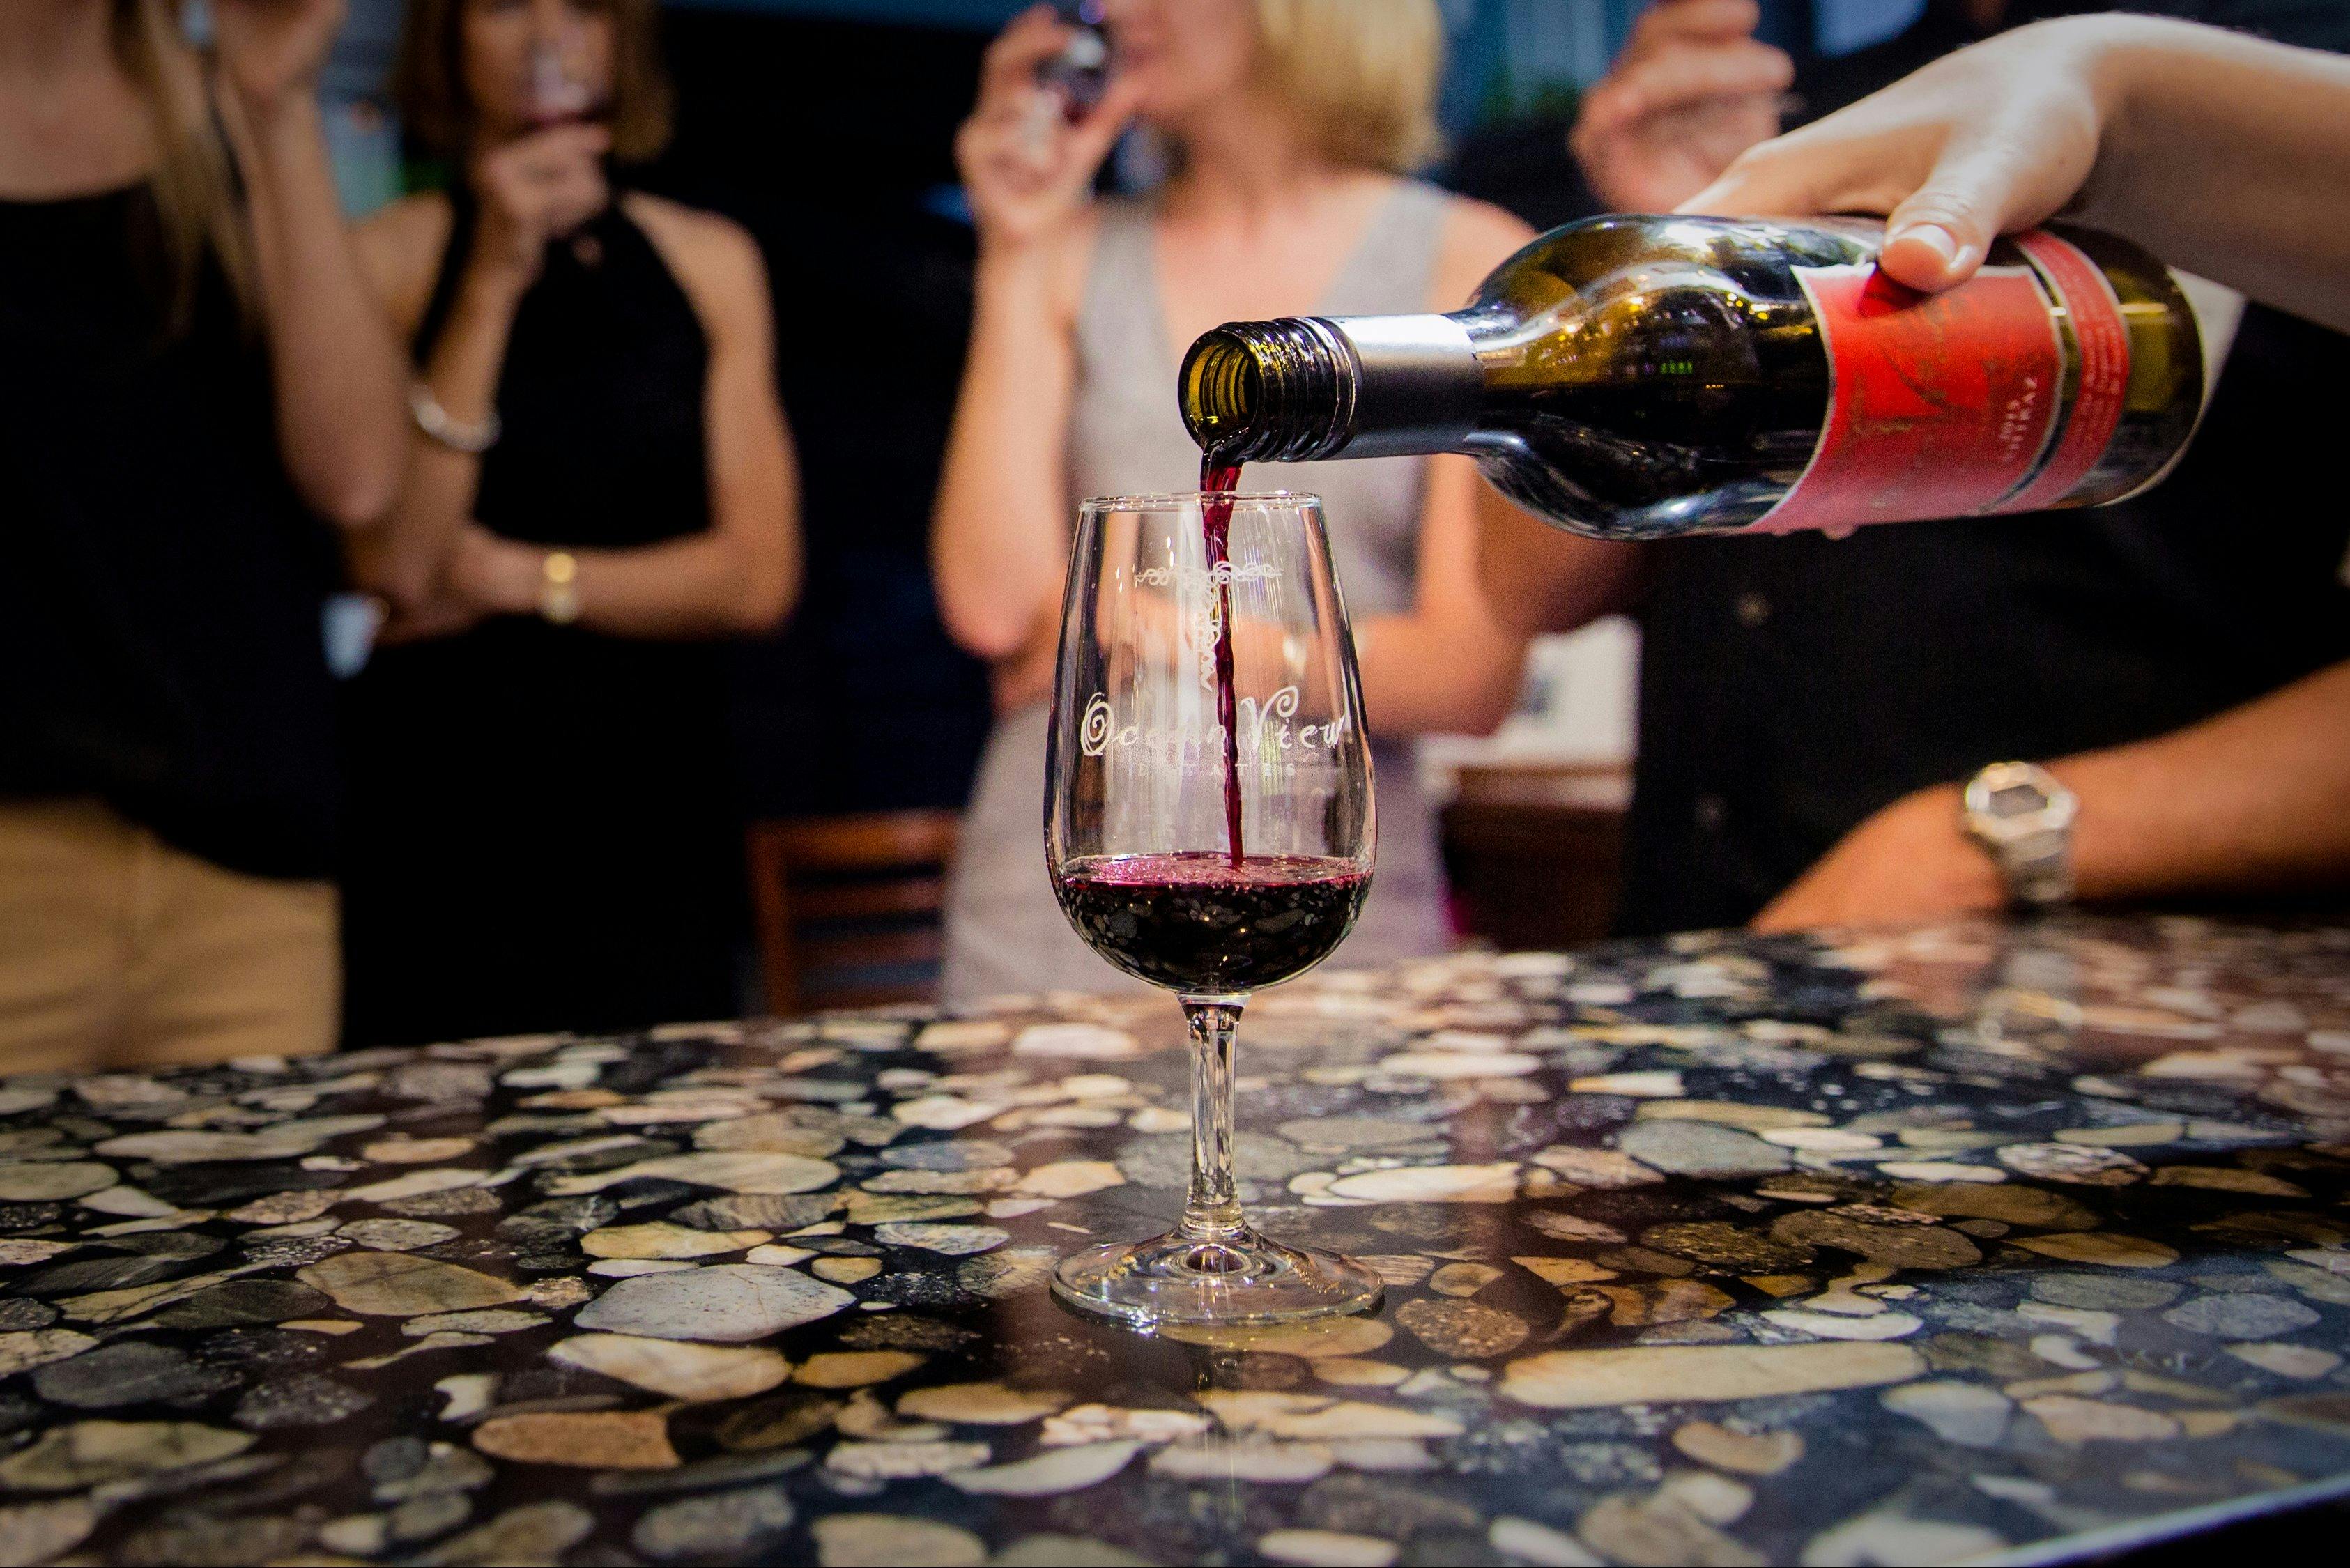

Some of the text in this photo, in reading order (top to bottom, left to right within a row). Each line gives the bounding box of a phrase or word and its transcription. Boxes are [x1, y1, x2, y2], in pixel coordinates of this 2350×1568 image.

[1081, 685, 1345, 756] Ocen View
[1139, 762, 1296, 777] ETATES
